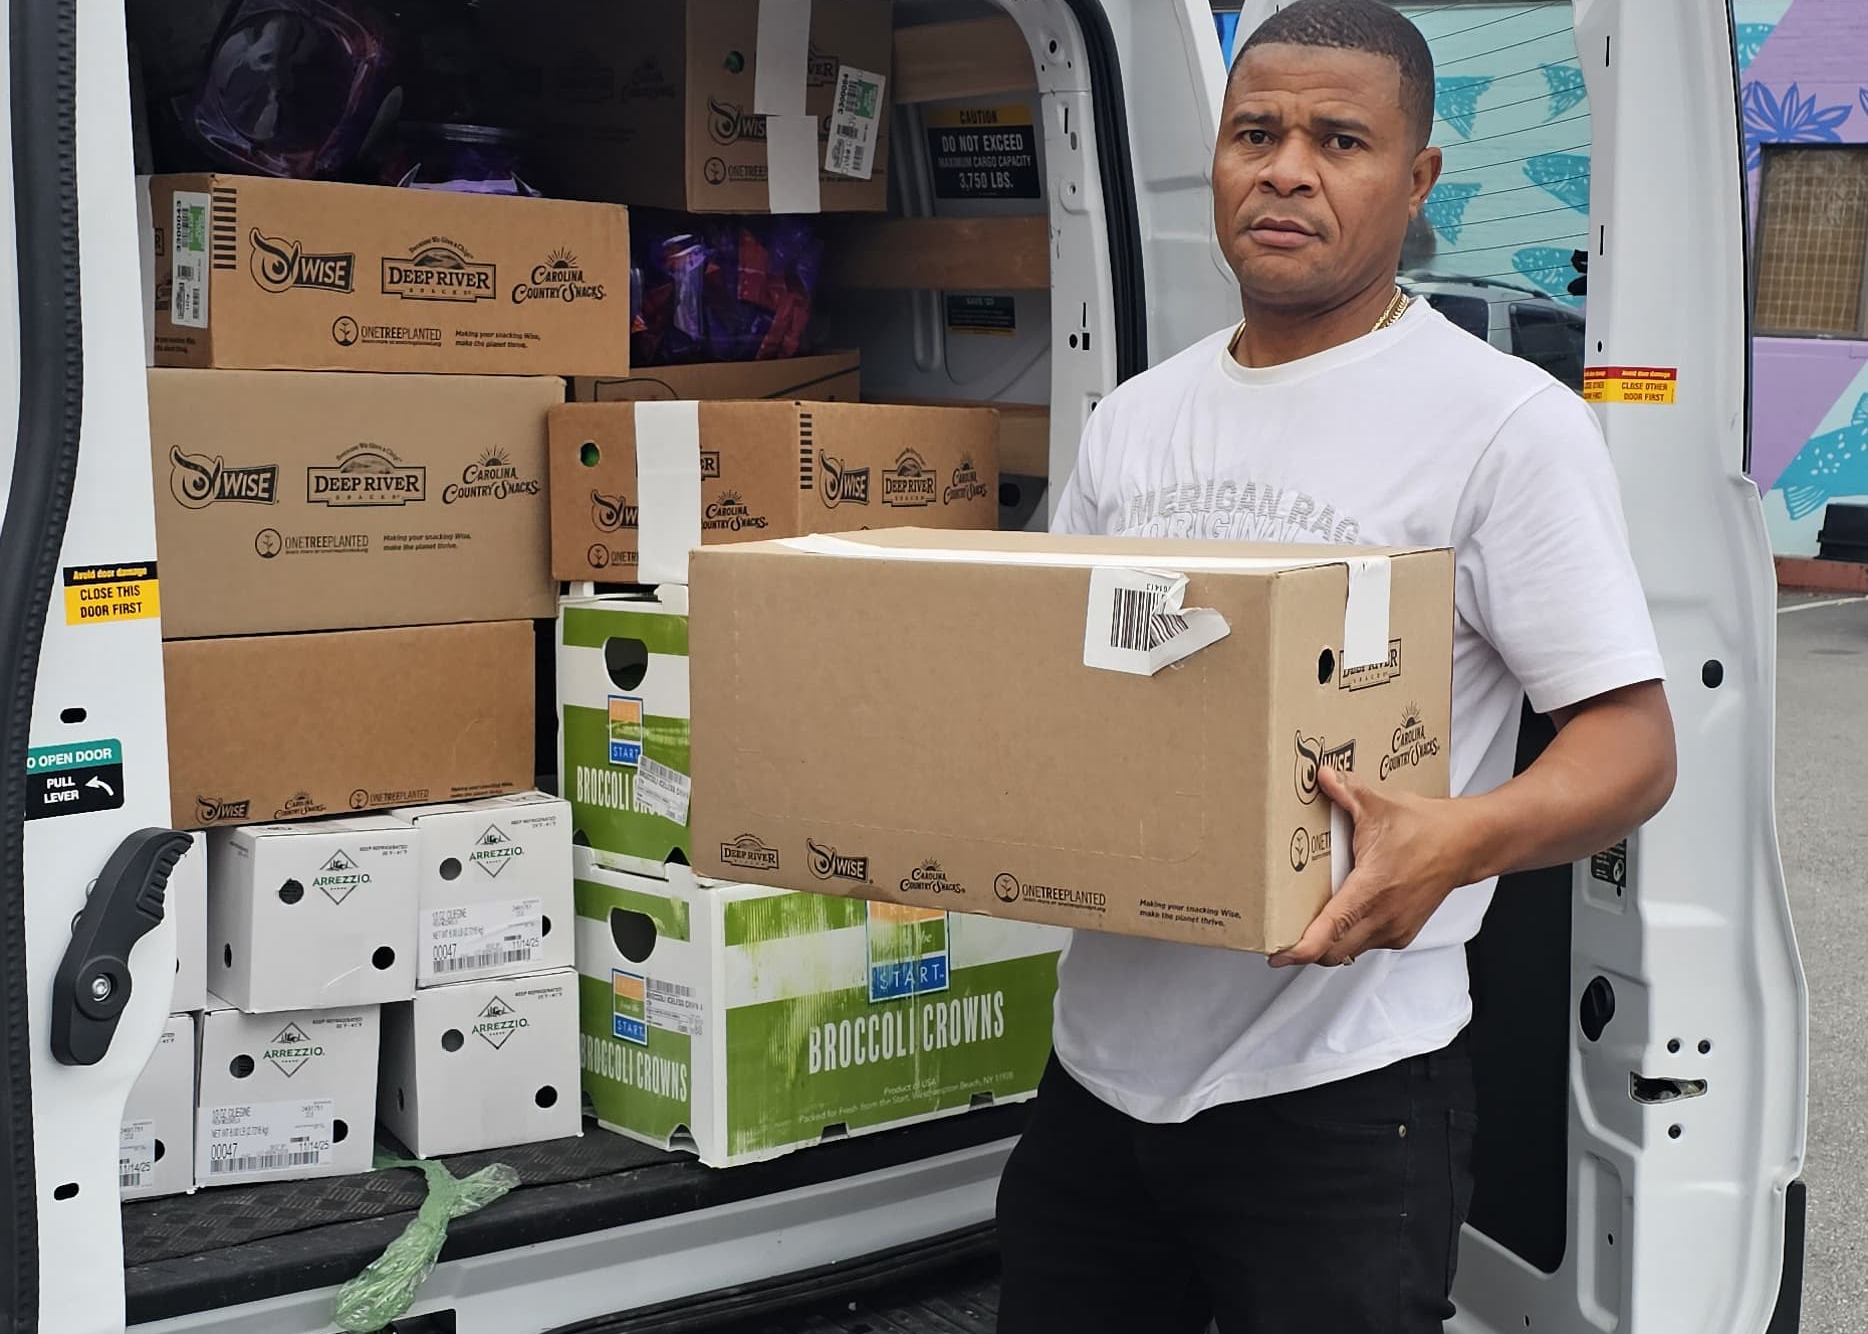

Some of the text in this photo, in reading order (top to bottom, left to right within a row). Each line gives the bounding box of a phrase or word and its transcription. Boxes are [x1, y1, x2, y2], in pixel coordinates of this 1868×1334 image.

[960, 109, 998, 124] CAUTION
[741, 119, 767, 136] WIS
[942, 133, 1023, 152] DO NOT EXCEED
[973, 155, 997, 168] CARGO
[998, 154, 1032, 167] CAPACITY
[959, 171, 1014, 191] 3,750 LBS.
[302, 259, 347, 286] WISE
[388, 266, 490, 290] DEEP RIVER
[531, 265, 584, 286] CAROLINA
[512, 281, 606, 304] COUNTRY SNACKS
[463, 464, 518, 484] CAROLINA
[223, 472, 271, 499] WISE
[314, 474, 419, 494] DEEP RIVER
[442, 479, 541, 505] COUNTRY SNACKS
[843, 475, 868, 499] WISE
[885, 477, 935, 495] DEEP RIVER
[706, 503, 749, 519] CAROLINA
[702, 516, 769, 531] OUNTRY SNACKS
[285, 535, 369, 549] ONETREEPLANTED
[80, 585, 140, 601] CLOSE THIS
[80, 602, 142, 618] DOOR FIRST
[1392, 725, 1426, 754] CAROLINA
[38, 752, 73, 767] OPEN
[75, 747, 112, 763] DOOR
[613, 746, 639, 760] START
[46, 776, 76, 789] PULL
[577, 765, 629, 811] BROCCOLI
[44, 789, 79, 804] LEVER
[218, 801, 247, 818] WISE
[469, 847, 522, 861] ARREZZIO
[724, 847, 746, 860] DEEP
[747, 851, 776, 864] RIVER
[836, 859, 865, 878] WISE
[911, 867, 948, 881] CAROLINA
[312, 873, 371, 887] ARREZZIO
[900, 878, 962, 894] COUNTRY SNACKS
[1022, 883, 1106, 906] ONETREEPLANTED
[1140, 898, 1242, 919] Making your snacking Wise,
[1140, 910, 1226, 927] make the planet thrive.
[432, 943, 457, 961] 00047
[879, 964, 940, 991] START
[472, 1018, 527, 1034] ARREZZIO
[617, 1019, 644, 1037] START
[809, 990, 1004, 1074] BROCCOLI CROWNS
[263, 1046, 324, 1060] ARREZZIO
[580, 1032, 688, 1103] BROCCOLI CROWNS
[884, 1084, 911, 1096] Product
[922, 1078, 938, 1089] USA
[799, 1110, 826, 1123] Packed
[827, 1108, 838, 1118] for
[839, 1104, 859, 1116] Fresh
[860, 1102, 878, 1111] from
[880, 1098, 891, 1107] the
[960, 1079, 982, 1090] Beach,
[983, 1076, 994, 1085] NY
[211, 1142, 238, 1160] 00047
[299, 1139, 329, 1151] 11/14/25
